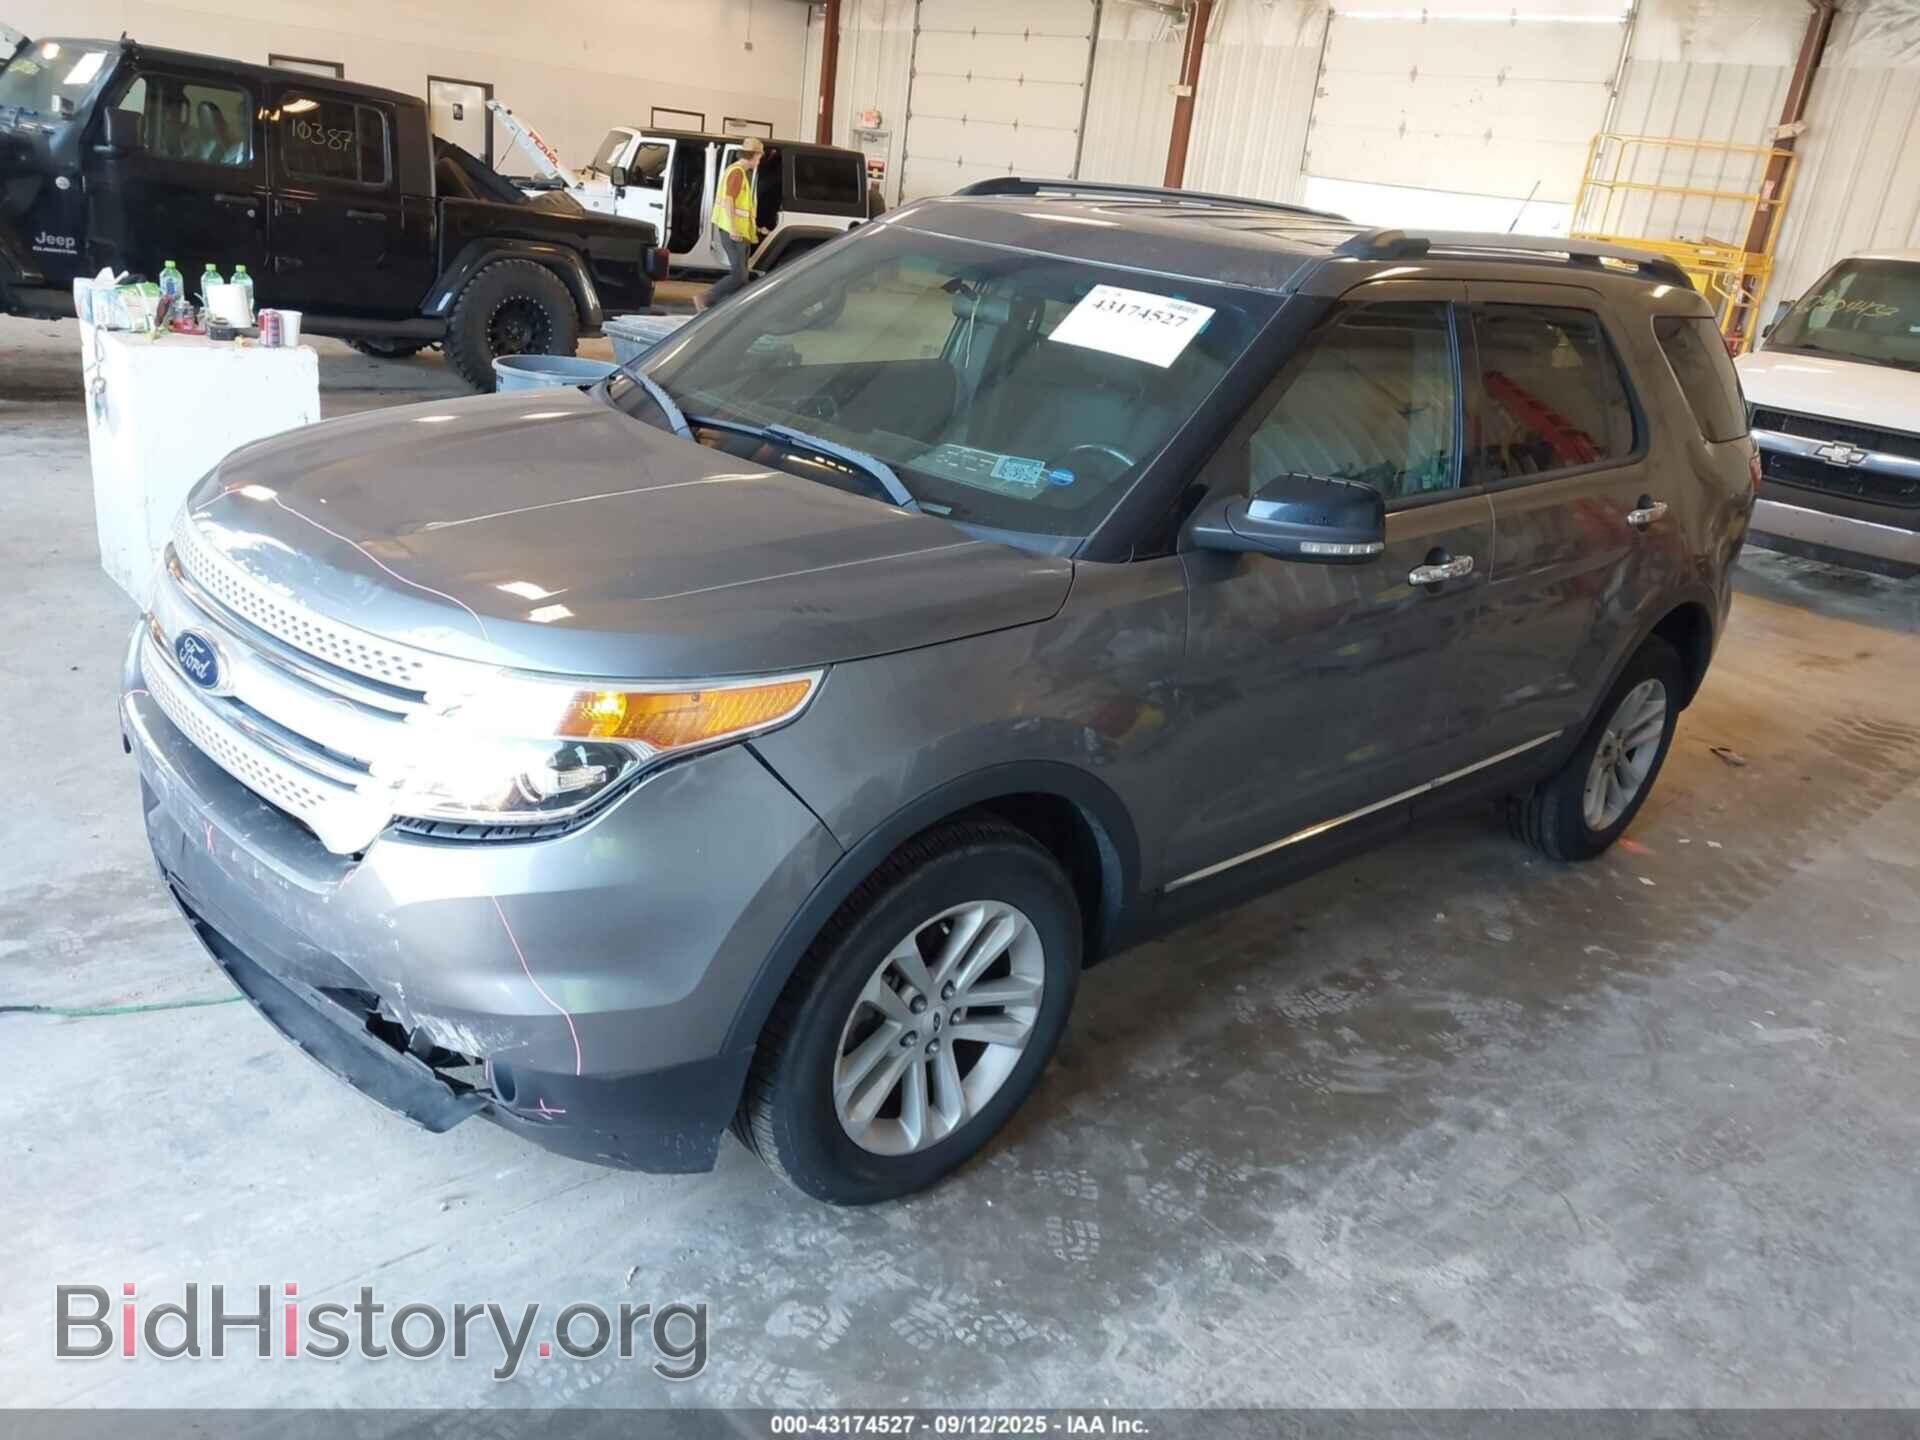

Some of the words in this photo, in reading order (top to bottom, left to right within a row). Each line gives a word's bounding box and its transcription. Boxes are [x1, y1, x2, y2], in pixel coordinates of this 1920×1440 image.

[291, 119, 353, 152] 10387
[35, 231, 76, 249] Jeep
[1090, 299, 1189, 328] 43174527
[180, 636, 210, 679] Ford
